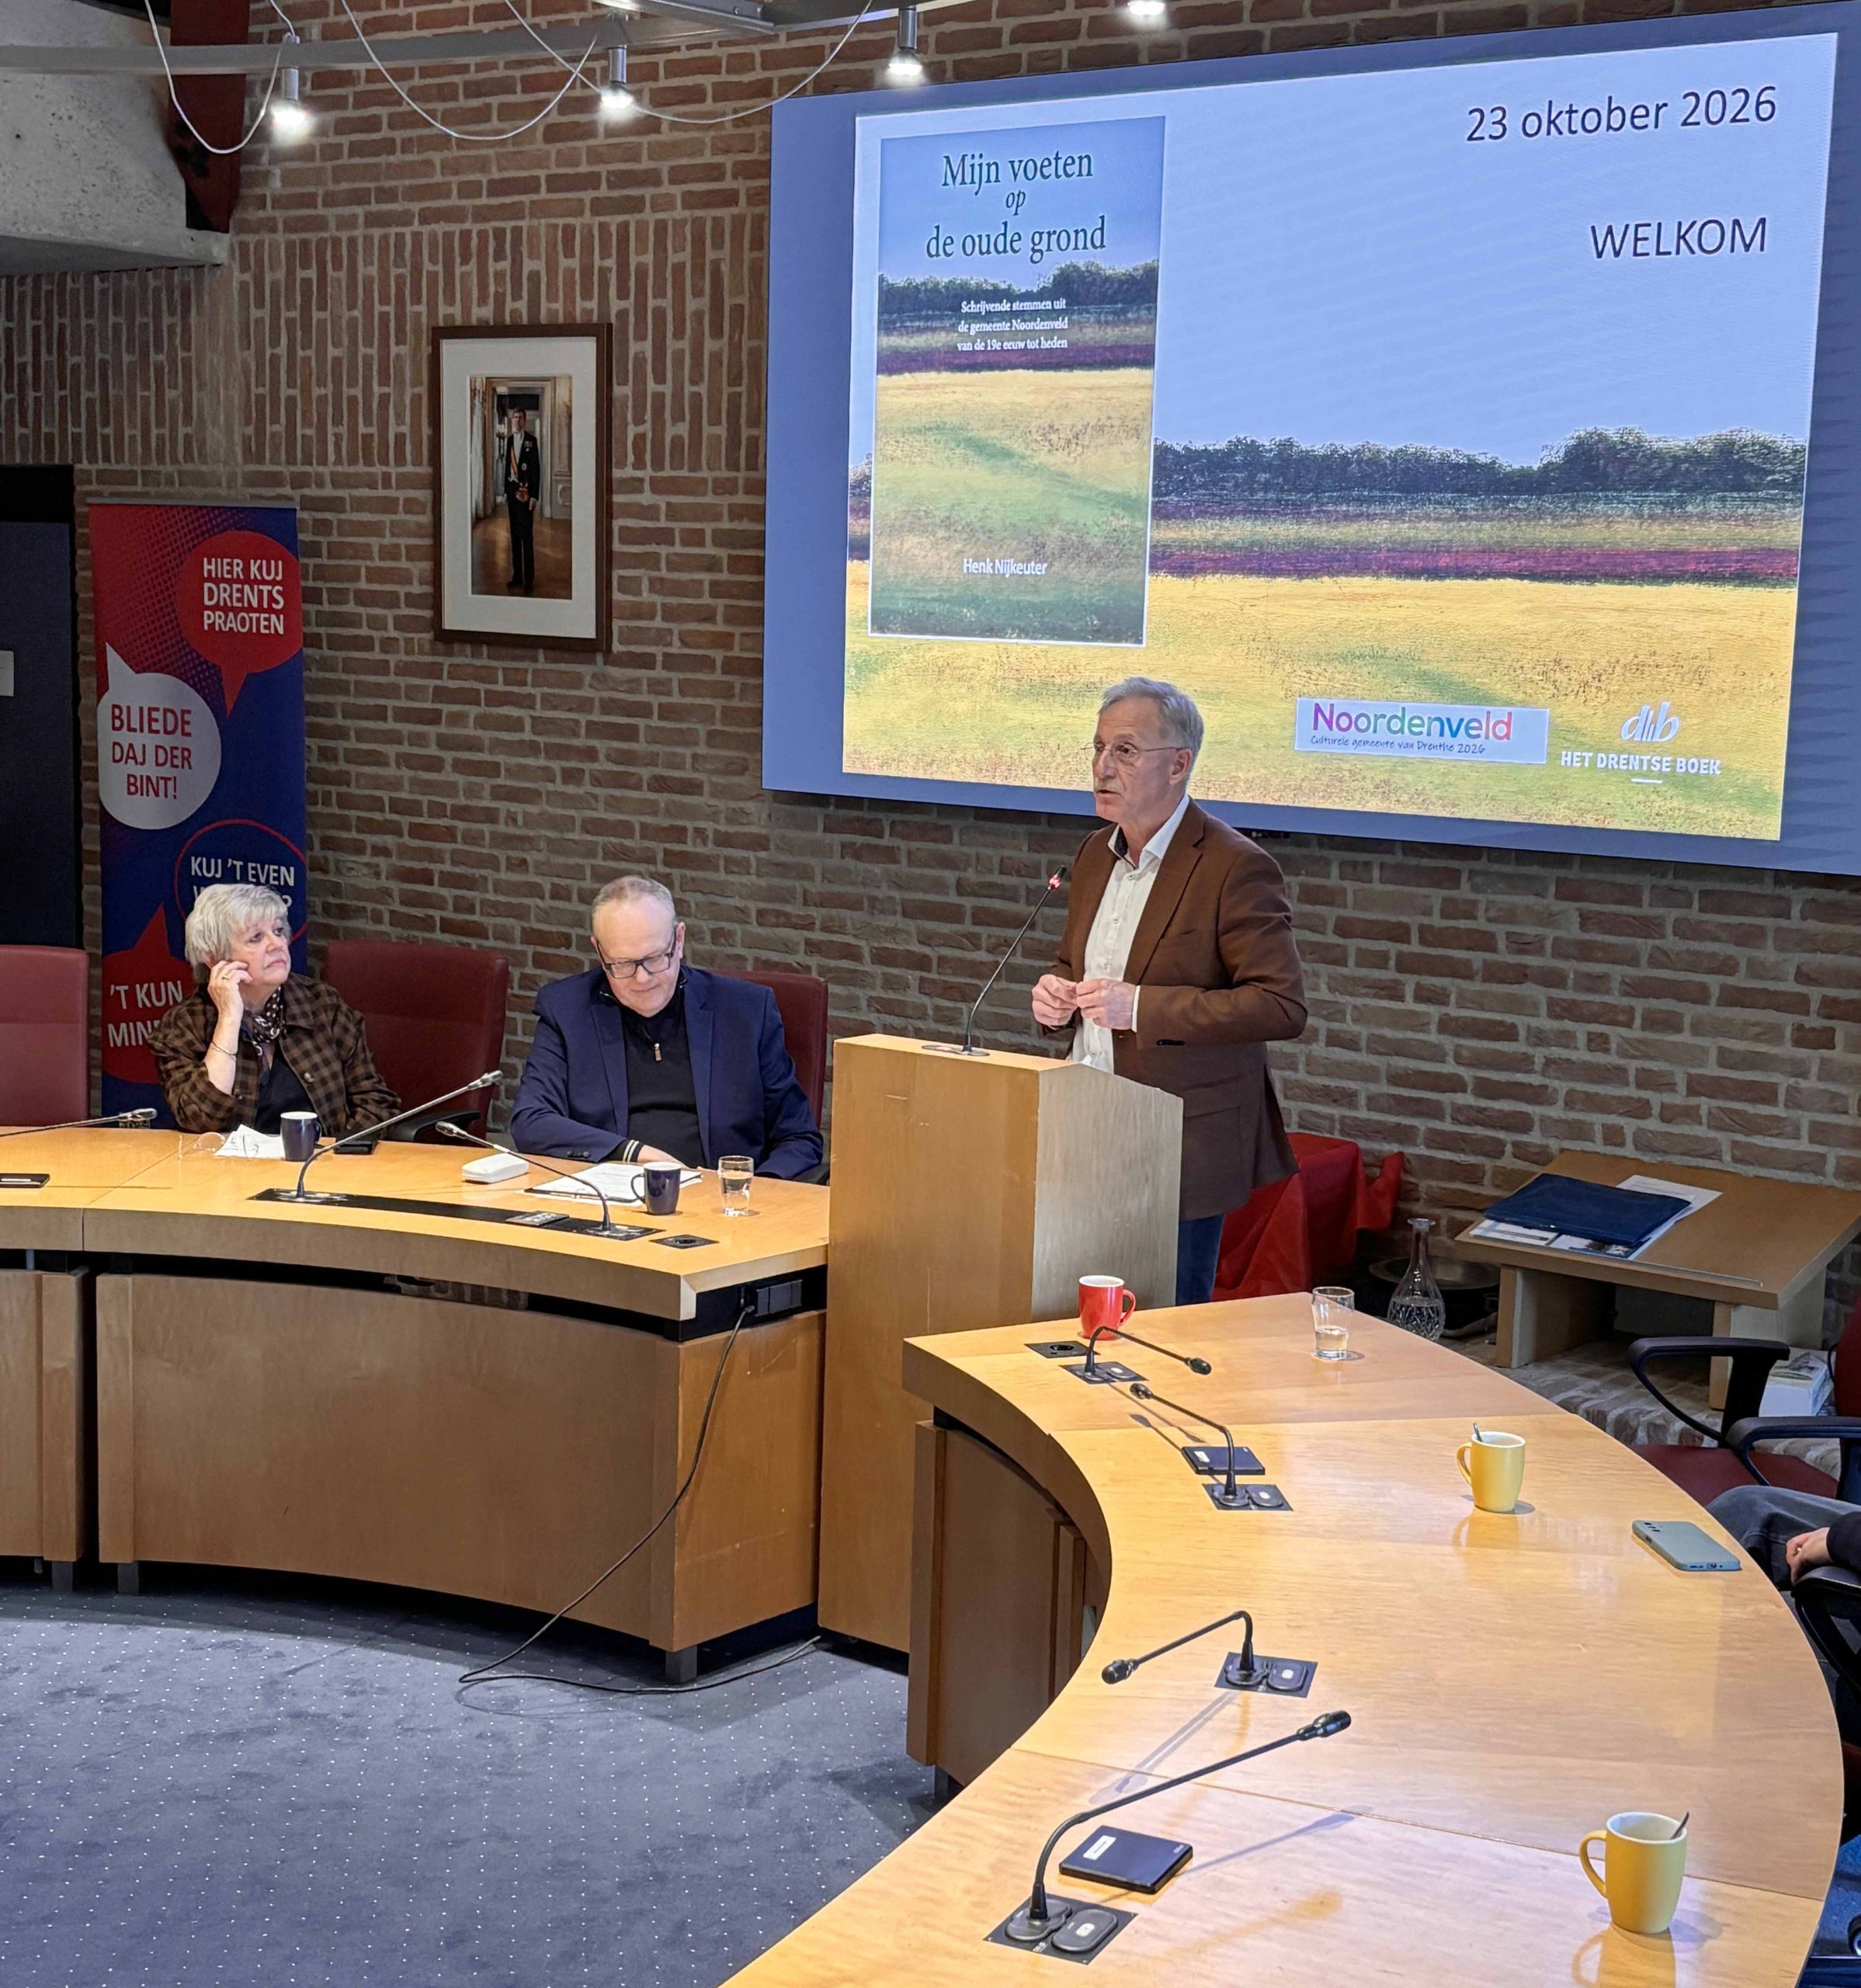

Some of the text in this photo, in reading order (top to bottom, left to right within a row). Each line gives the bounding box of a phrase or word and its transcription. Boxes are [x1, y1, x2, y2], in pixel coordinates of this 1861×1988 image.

[1467, 85, 1776, 141] 23 oktober 2026
[942, 151, 1093, 196] Mijn voeten
[1005, 189, 1026, 216] op
[926, 214, 1106, 265] de oude grond
[1591, 217, 1767, 259] WELKOM
[961, 297, 1067, 315] Schrijvende stemmen uit
[958, 317, 1068, 335] de gemeente Noordenveld
[957, 336, 1068, 352] van de 19e eeuw tot heden
[203, 557, 283, 581] HIER KUJ
[963, 558, 1047, 578] Henk Nijkeuter
[203, 582, 284, 610] DRENTS
[203, 610, 284, 635] PRAOTEN
[111, 704, 193, 738] BLIEDE
[1313, 702, 1513, 741] Noordenveld
[112, 743, 193, 770] DAJ DER
[1311, 735, 1349, 746] Culturele
[1352, 739, 1394, 750] gemeente
[1417, 741, 1454, 752] Drenthe
[1457, 743, 1485, 754] 2026
[1561, 750, 1721, 776] HET DRENTSE BOEK
[126, 773, 178, 800] BINT!
[190, 856, 222, 878] KUJ
[248, 862, 295, 887] EVEN
[136, 980, 183, 1008] KUN
[107, 1019, 161, 1048] MIN
